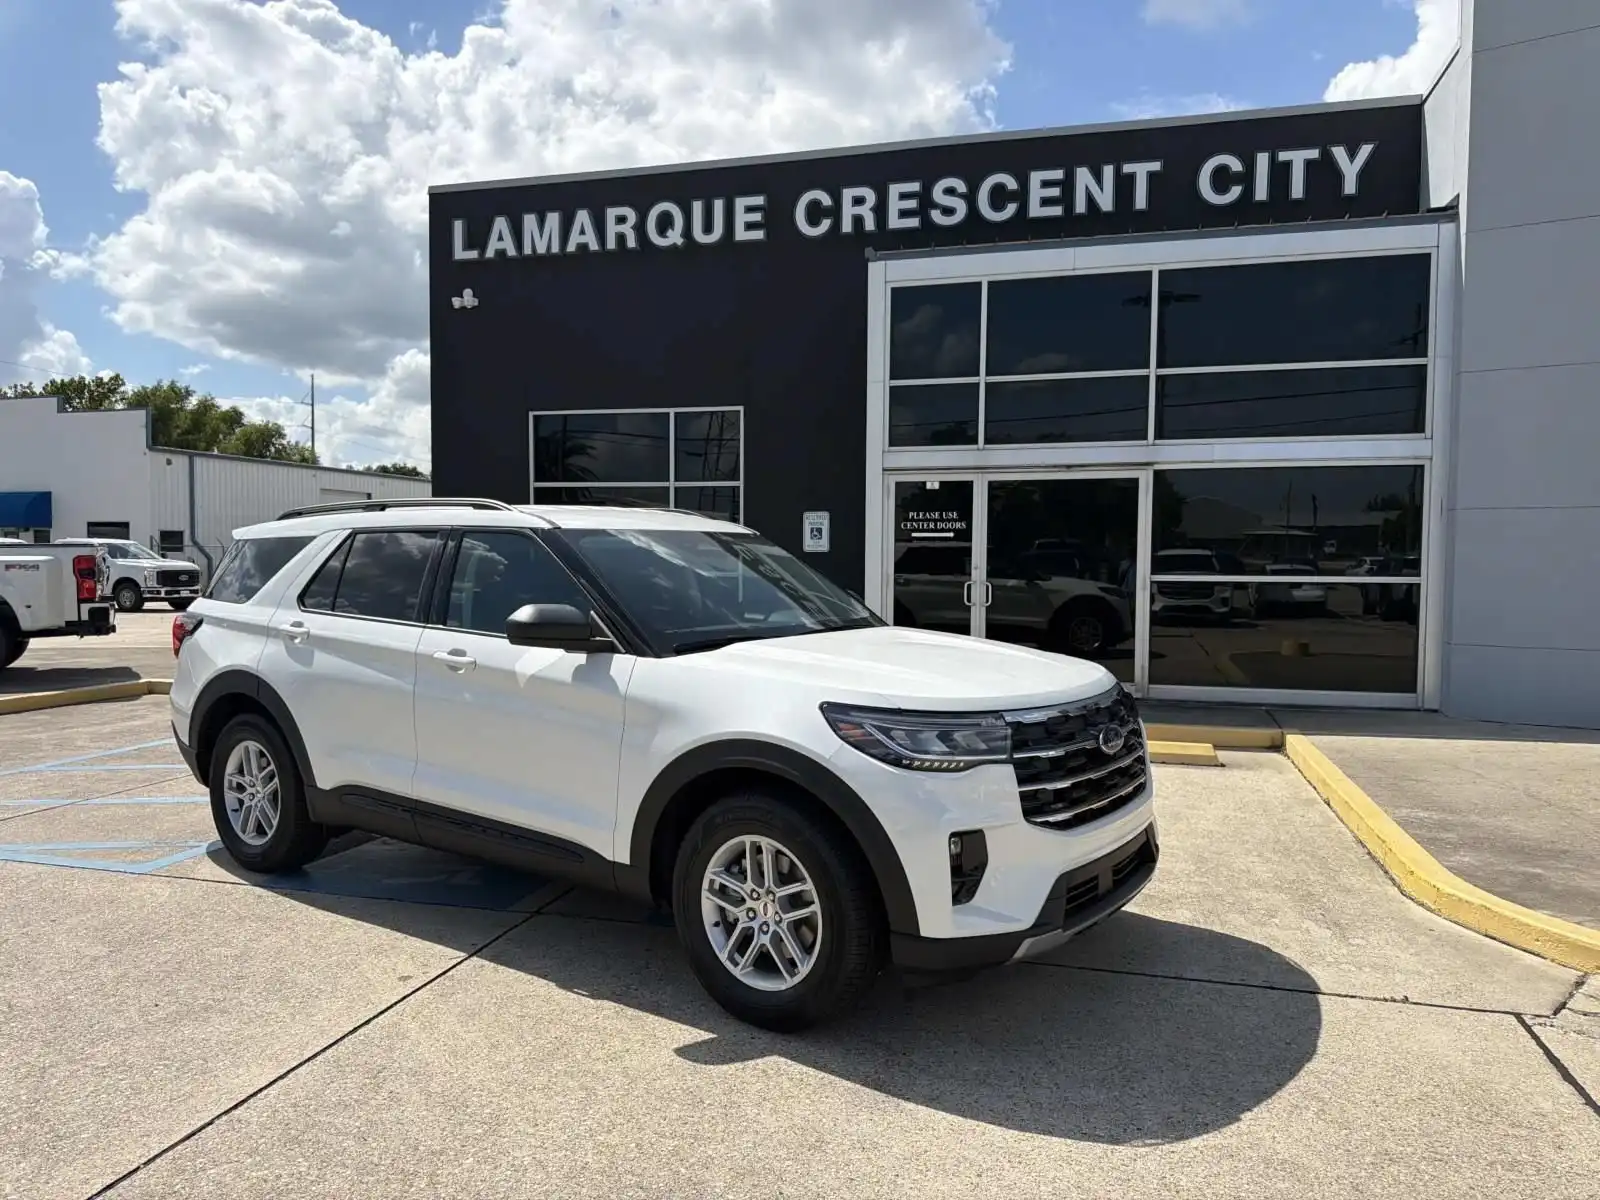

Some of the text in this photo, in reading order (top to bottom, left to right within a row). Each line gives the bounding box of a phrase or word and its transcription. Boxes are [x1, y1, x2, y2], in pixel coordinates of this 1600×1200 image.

[453, 143, 1375, 260] LAMARQUE CRESCENT CITY
[909, 511, 959, 520] PLEASE USE
[901, 521, 967, 530] CENTER DOORS
